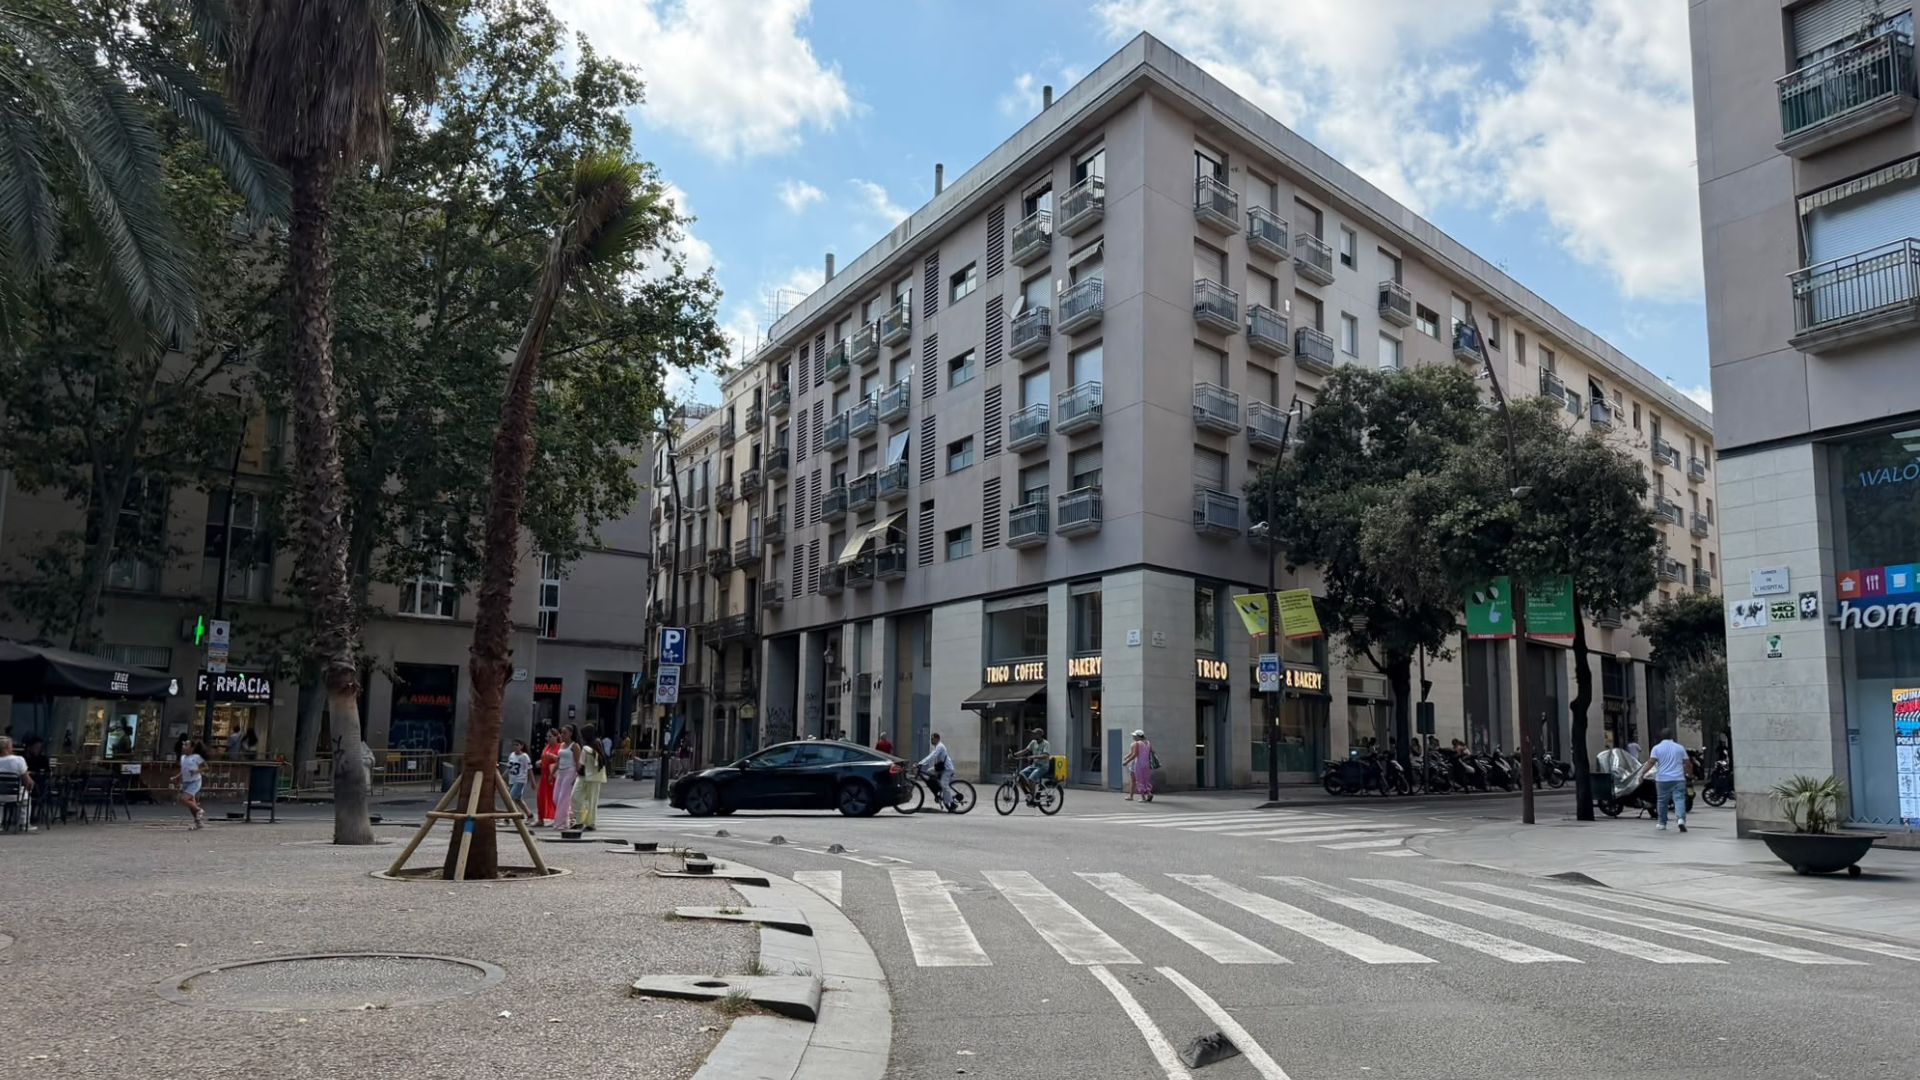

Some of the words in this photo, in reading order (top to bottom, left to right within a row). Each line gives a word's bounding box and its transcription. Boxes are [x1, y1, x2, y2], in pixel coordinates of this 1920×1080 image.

[666, 630, 681, 650] P
[987, 665, 1009, 683] TRIGO
[1014, 662, 1044, 681] COFFEE
[1069, 657, 1102, 676] BAKERY
[1196, 659, 1228, 680] TRIGO
[111, 681, 129, 692] COFFEE
[1294, 670, 1322, 690] BAKERY
